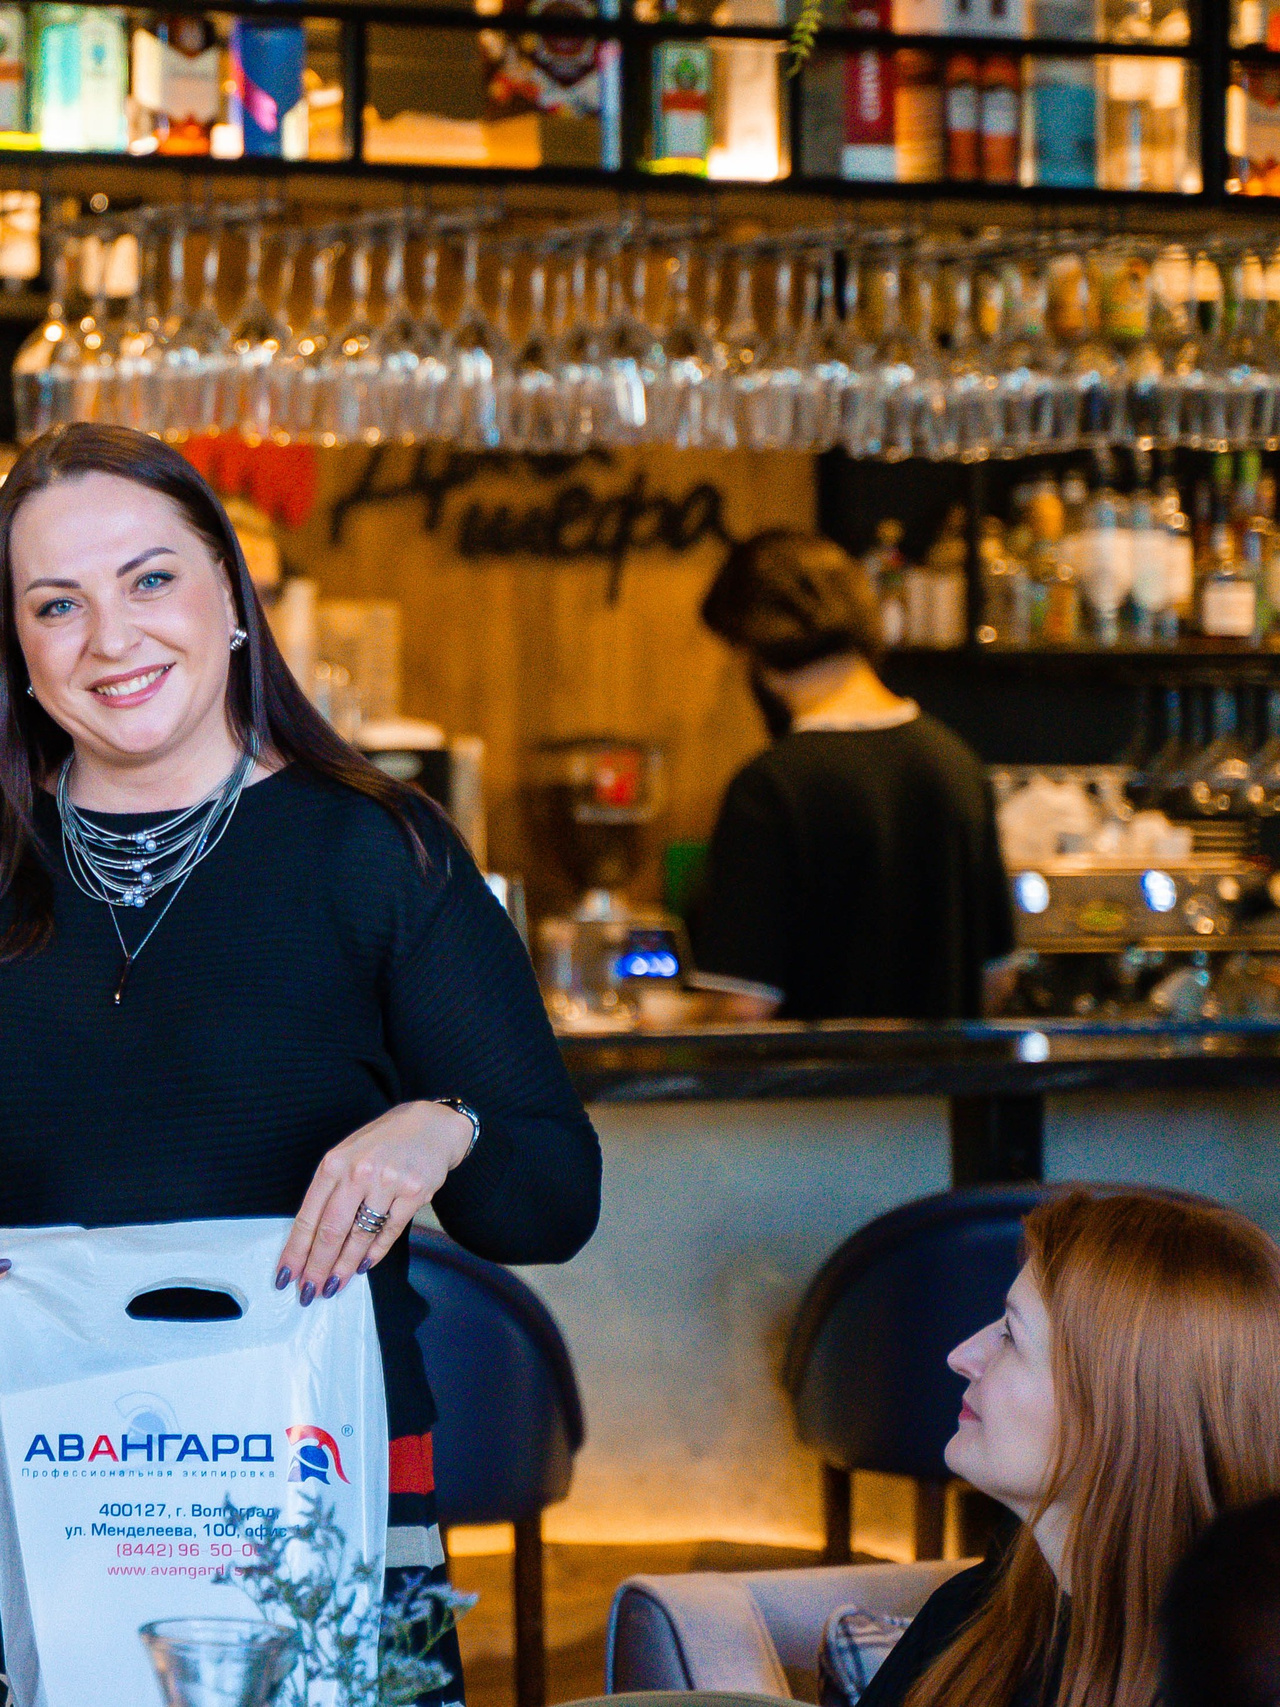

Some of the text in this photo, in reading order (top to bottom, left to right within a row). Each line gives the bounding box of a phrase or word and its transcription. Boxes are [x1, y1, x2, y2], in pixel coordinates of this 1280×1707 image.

[24, 1434, 274, 1462] АВАНГАРД
[21, 1467, 275, 1480] Профессиональная экипировка
[99, 1503, 171, 1519] 400127,
[176, 1507, 186, 1517] г.
[65, 1526, 86, 1539] ул.
[91, 1523, 197, 1538] Менделеева,
[203, 1523, 240, 1538] 100,
[116, 1543, 173, 1558] (8442)
